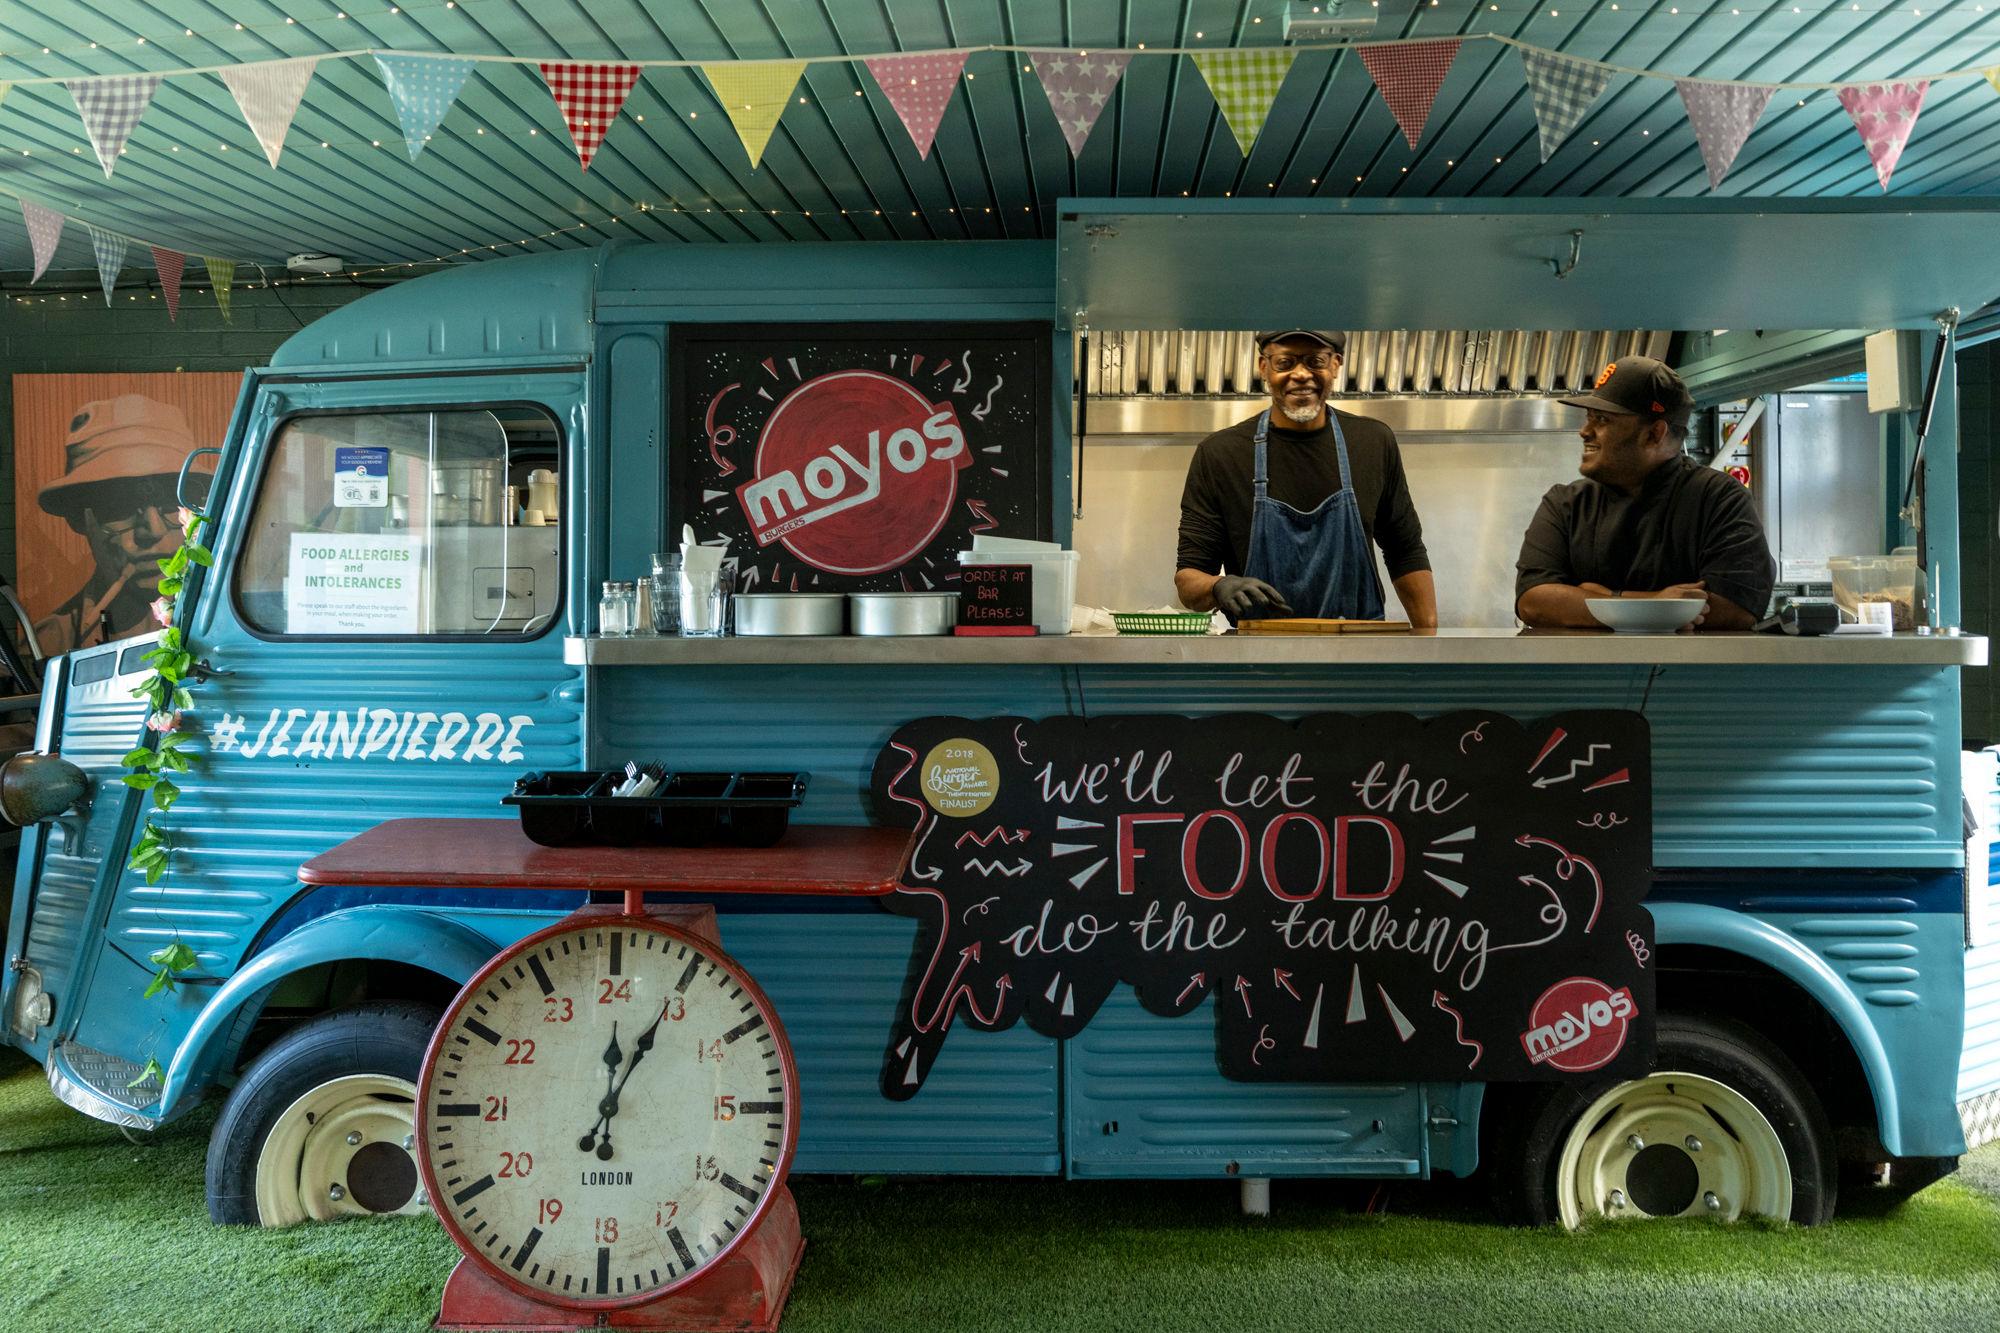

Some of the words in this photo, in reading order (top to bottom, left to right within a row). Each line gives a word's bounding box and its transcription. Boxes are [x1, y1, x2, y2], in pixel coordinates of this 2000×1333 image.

[764, 517, 806, 541] BURGERS
[301, 548, 336, 560] FOOD
[339, 548, 409, 562] ALLERGIES
[344, 563, 363, 573] and
[305, 575, 402, 589] INTOLERANCES
[964, 569, 1007, 582] ORDER
[1012, 571, 1025, 582] AT
[978, 585, 999, 600] BAR
[967, 605, 1014, 619] PLEASE
[208, 706, 535, 763] #JEANPIERRE
[946, 748, 974, 758] 2018
[927, 765, 981, 793] Burger
[1215, 752, 1316, 808] let
[1352, 761, 1469, 814] the
[940, 799, 978, 809] FINALIST
[1116, 809, 1406, 903] FOOD
[999, 899, 1119, 957] do
[1129, 900, 1247, 952] the
[1271, 902, 1490, 991] talking
[598, 978, 632, 1004] 24
[543, 997, 574, 1023] 23
[505, 1039, 535, 1065] 22
[699, 1038, 724, 1063] 14
[484, 1095, 508, 1122] 21
[714, 1095, 736, 1121] 15
[498, 1152, 533, 1178] 20
[581, 1171, 633, 1186] LONDON
[538, 1199, 563, 1225] 19
[656, 1201, 679, 1228] 17
[595, 1217, 619, 1244] 18
